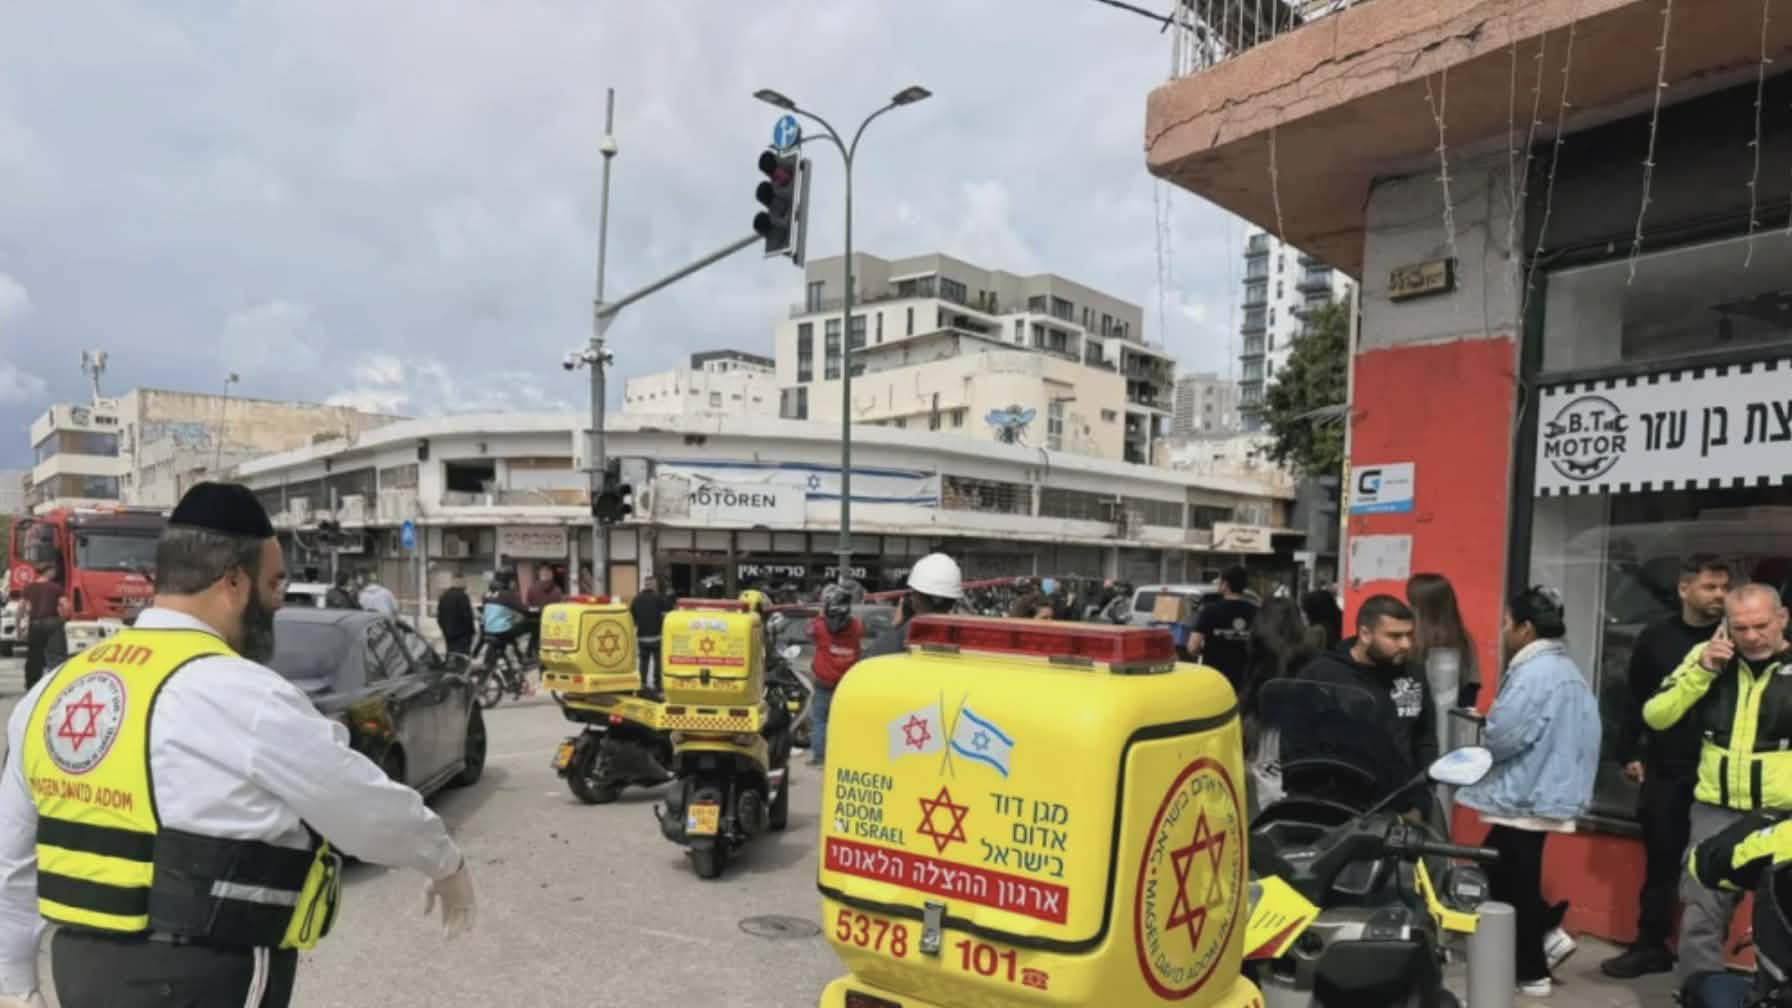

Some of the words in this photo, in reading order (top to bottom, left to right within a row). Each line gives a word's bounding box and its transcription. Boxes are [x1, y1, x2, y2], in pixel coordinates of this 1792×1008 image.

[1569, 410, 1605, 434] B.T
[1640, 410, 1687, 451] עזר
[1701, 406, 1728, 457] בן
[1544, 435, 1626, 458] MOTOR
[87, 643, 153, 665] חובש
[837, 768, 893, 790] MAGEN
[94, 787, 133, 812] ADOM
[836, 784, 884, 805] DAVID
[989, 792, 1025, 818] דוד
[834, 801, 884, 823] ADOM
[1032, 799, 1070, 825] מגן
[855, 821, 906, 846] ISRAEL
[1012, 822, 1068, 852] אדום
[831, 843, 905, 880] הלאומי
[980, 837, 1065, 878] בישראל
[912, 861, 988, 899] ההצלה
[997, 878, 1061, 915] ארגון
[1144, 879, 1161, 955] MAGEN
[836, 907, 908, 959] 5378
[955, 938, 1017, 983] 101
